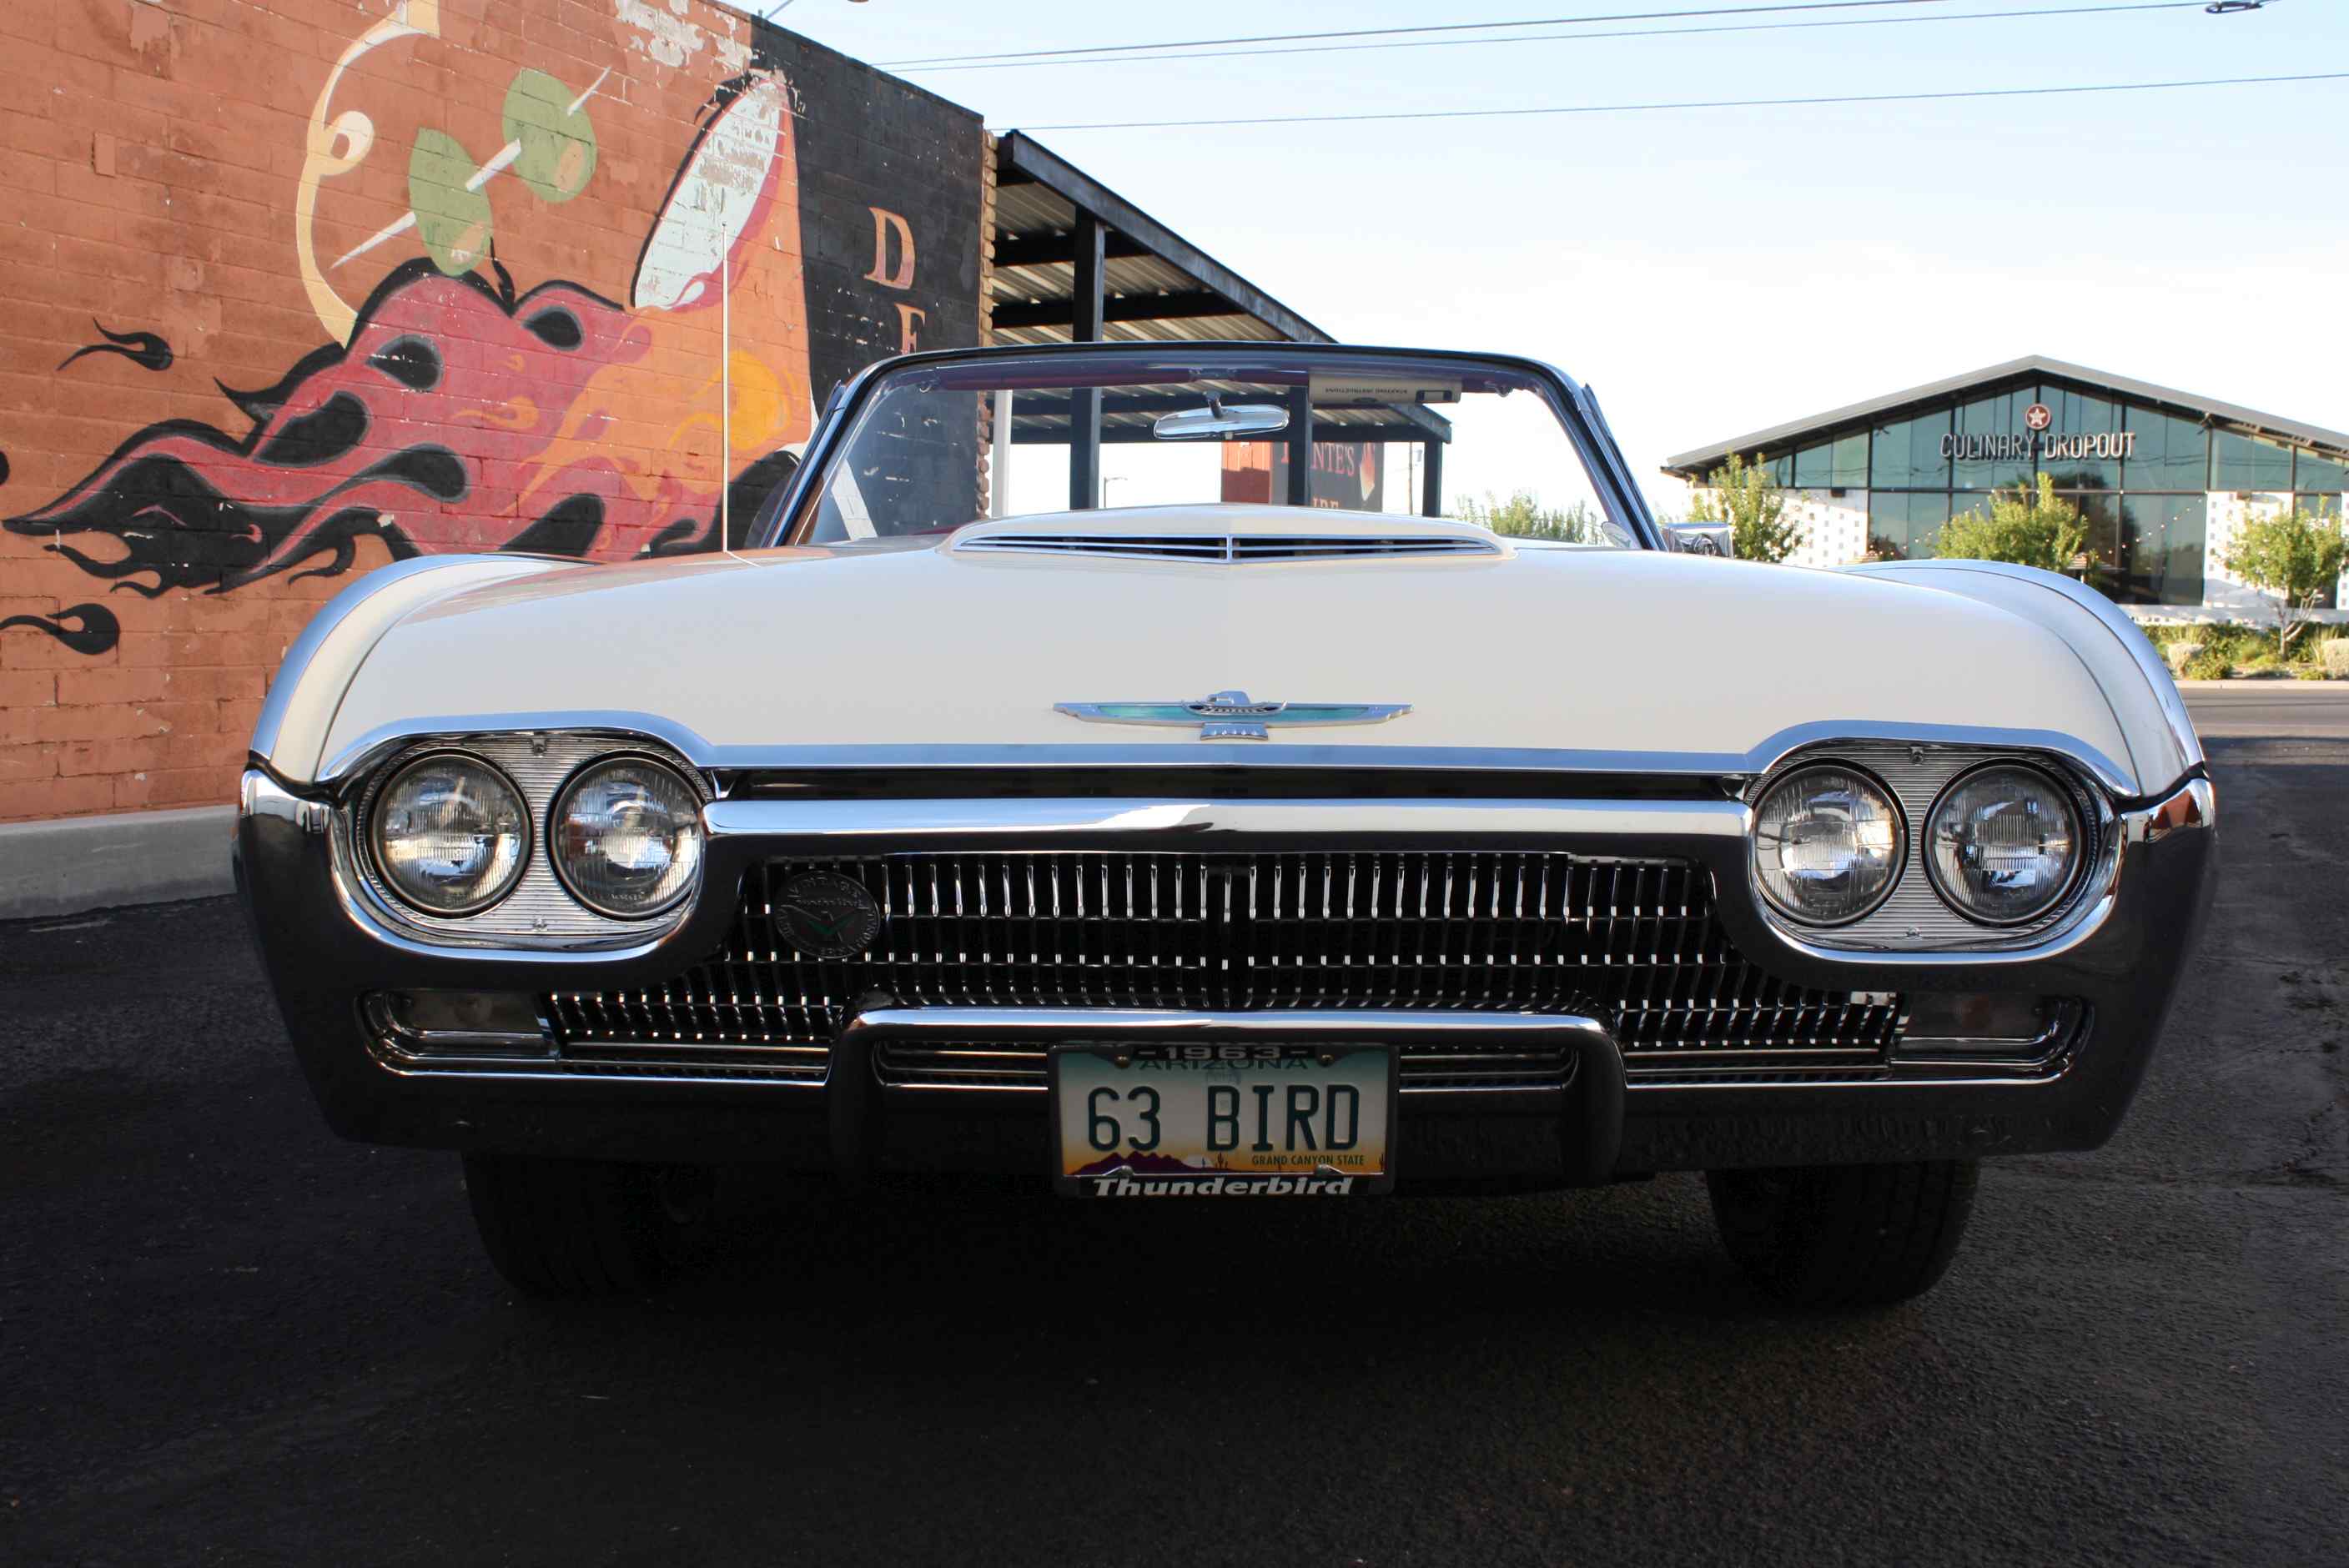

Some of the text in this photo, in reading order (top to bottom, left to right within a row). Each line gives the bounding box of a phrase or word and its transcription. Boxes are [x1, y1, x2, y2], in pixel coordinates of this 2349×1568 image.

[863, 207, 915, 289] D
[1939, 432, 2136, 459] CULINARY DROPOUT
[1088, 1085, 1360, 1152] 63 BIRD
[1251, 1153, 1366, 1166] GRAND CANYON STATE
[1093, 1176, 1355, 1197] Thunderbird
